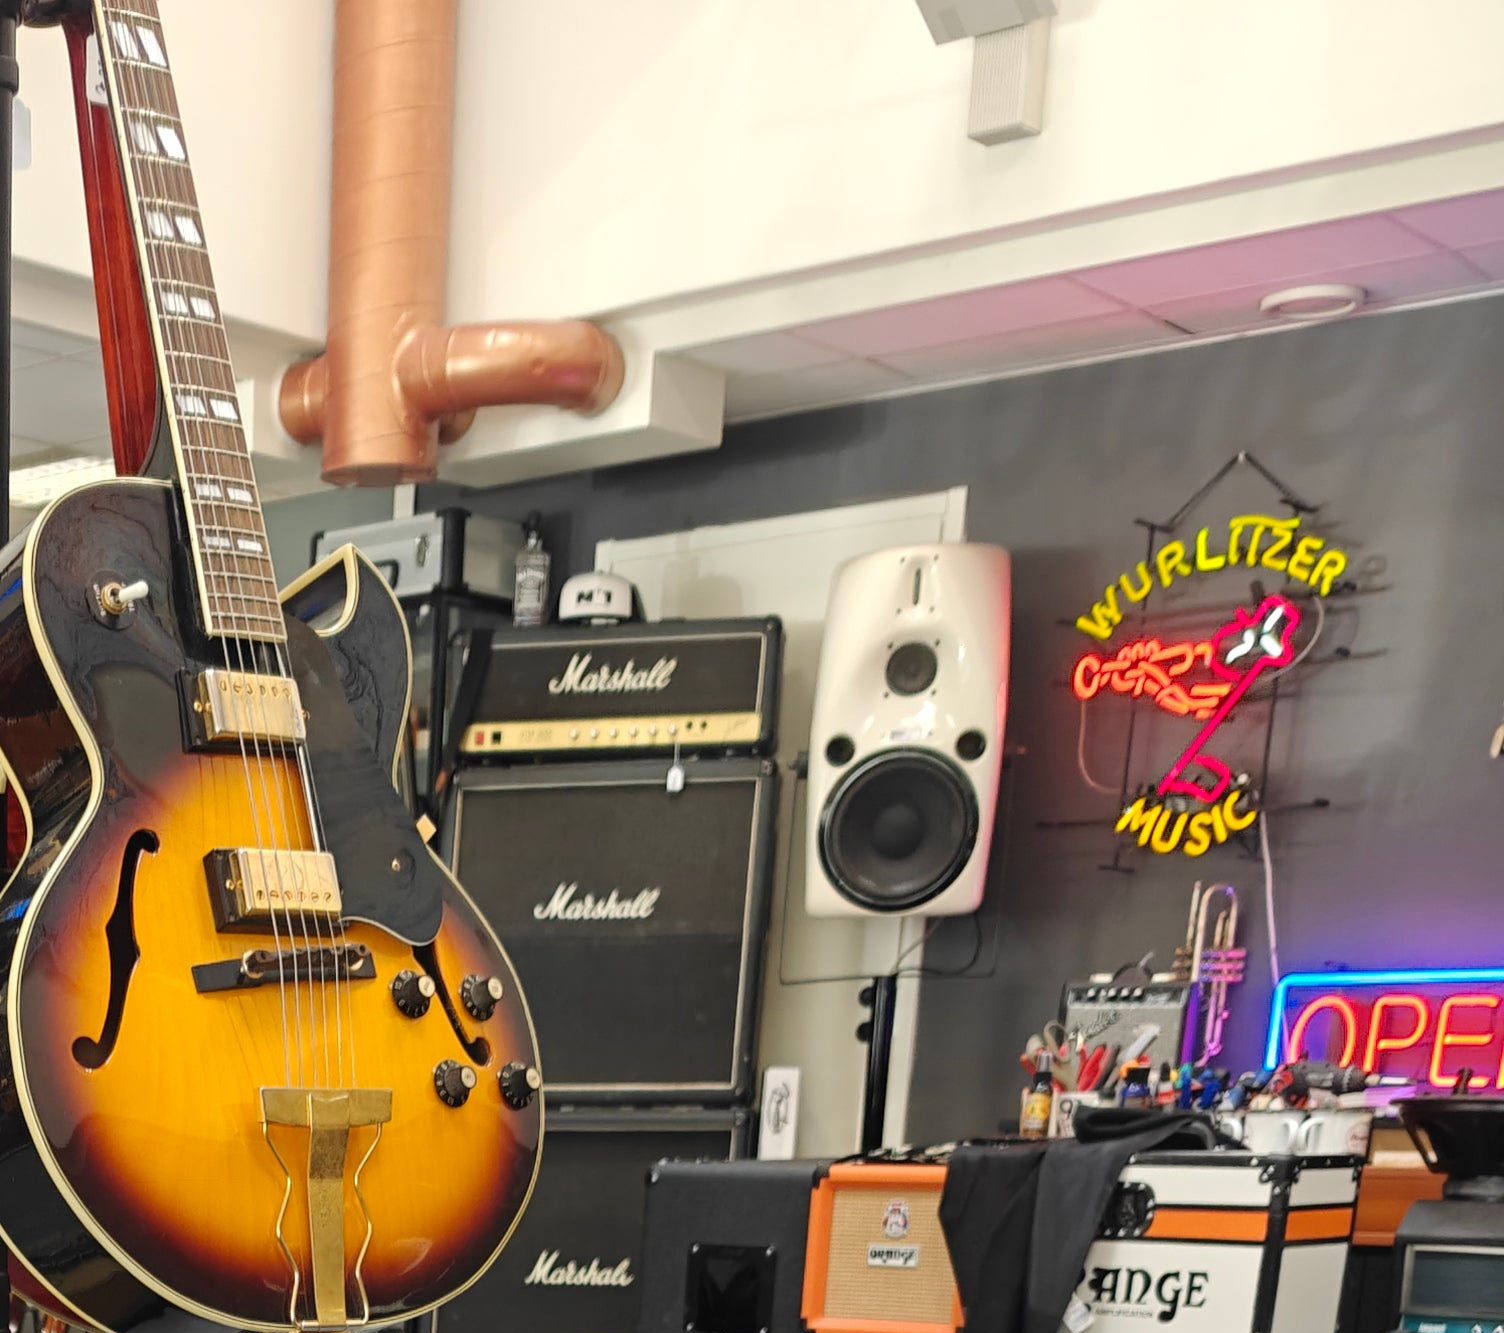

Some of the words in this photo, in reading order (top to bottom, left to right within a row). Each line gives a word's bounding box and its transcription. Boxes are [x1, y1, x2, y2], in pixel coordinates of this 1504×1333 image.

[1075, 515, 1346, 640] WURLITZER
[549, 652, 678, 695] Marshall
[1115, 790, 1257, 857] MUSIC
[533, 881, 661, 920] Marshall
[1288, 993, 1504, 1090] OPE
[1075, 1267, 1209, 1323] ANGE
